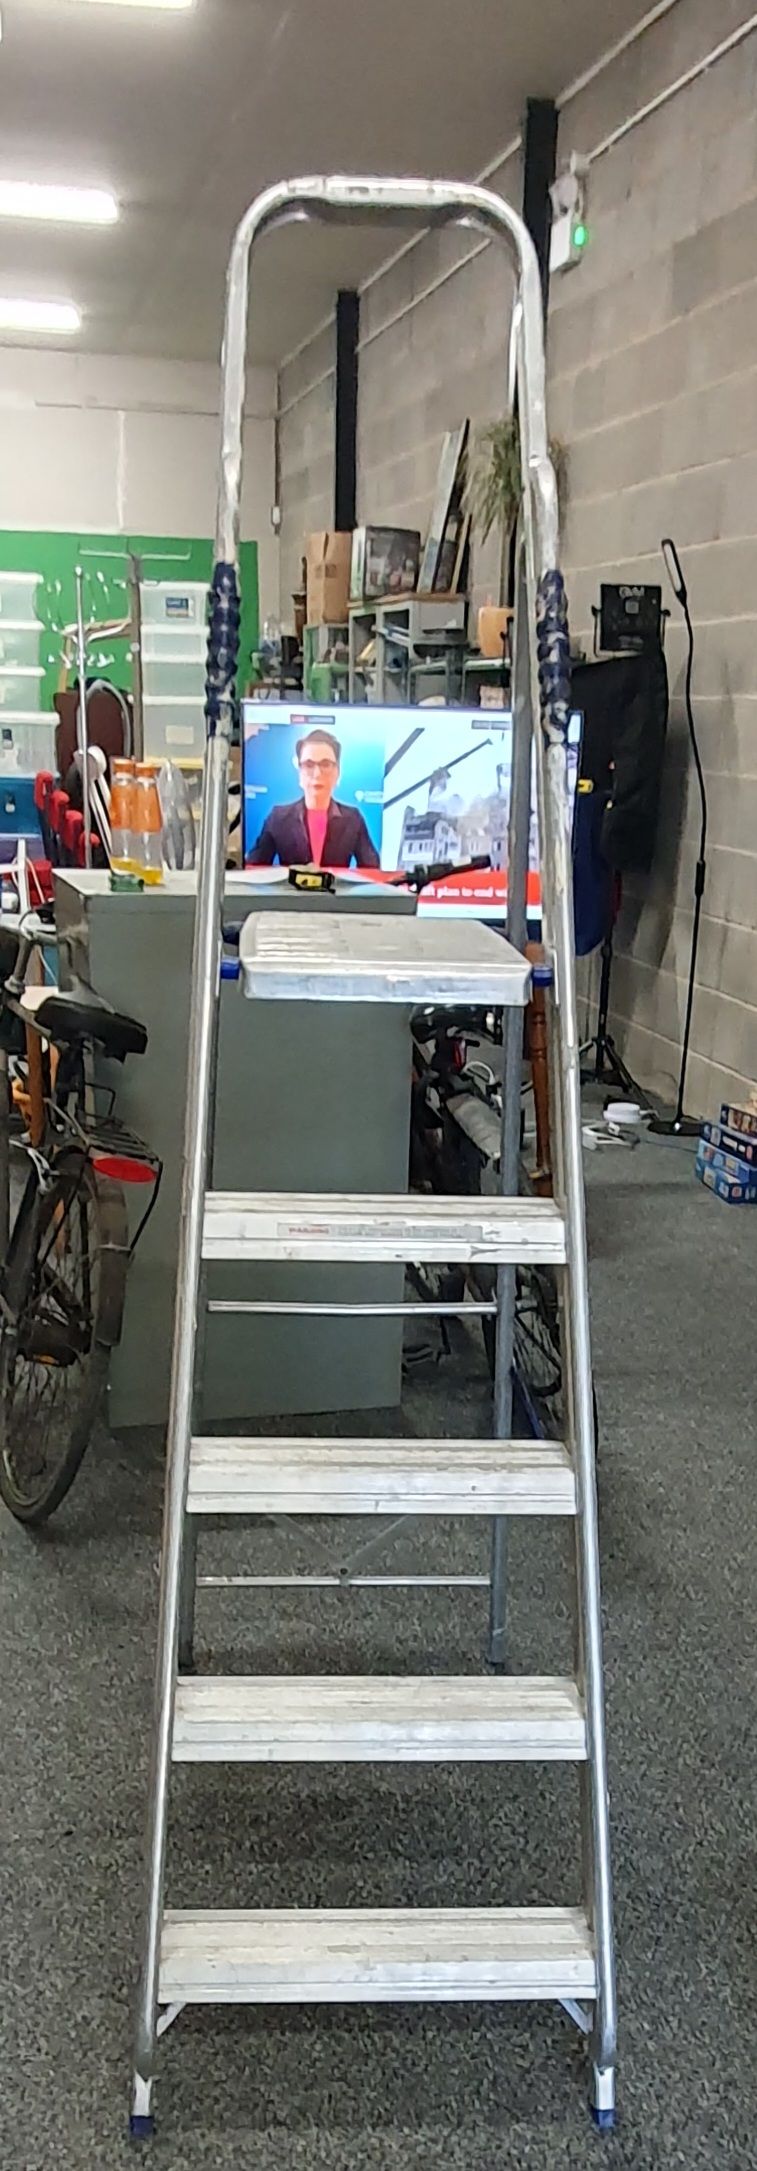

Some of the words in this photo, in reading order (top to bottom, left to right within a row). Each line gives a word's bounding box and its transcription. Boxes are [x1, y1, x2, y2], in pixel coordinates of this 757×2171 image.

[437, 886, 460, 899] plan
[461, 886, 473, 897] to
[473, 886, 494, 897] end
